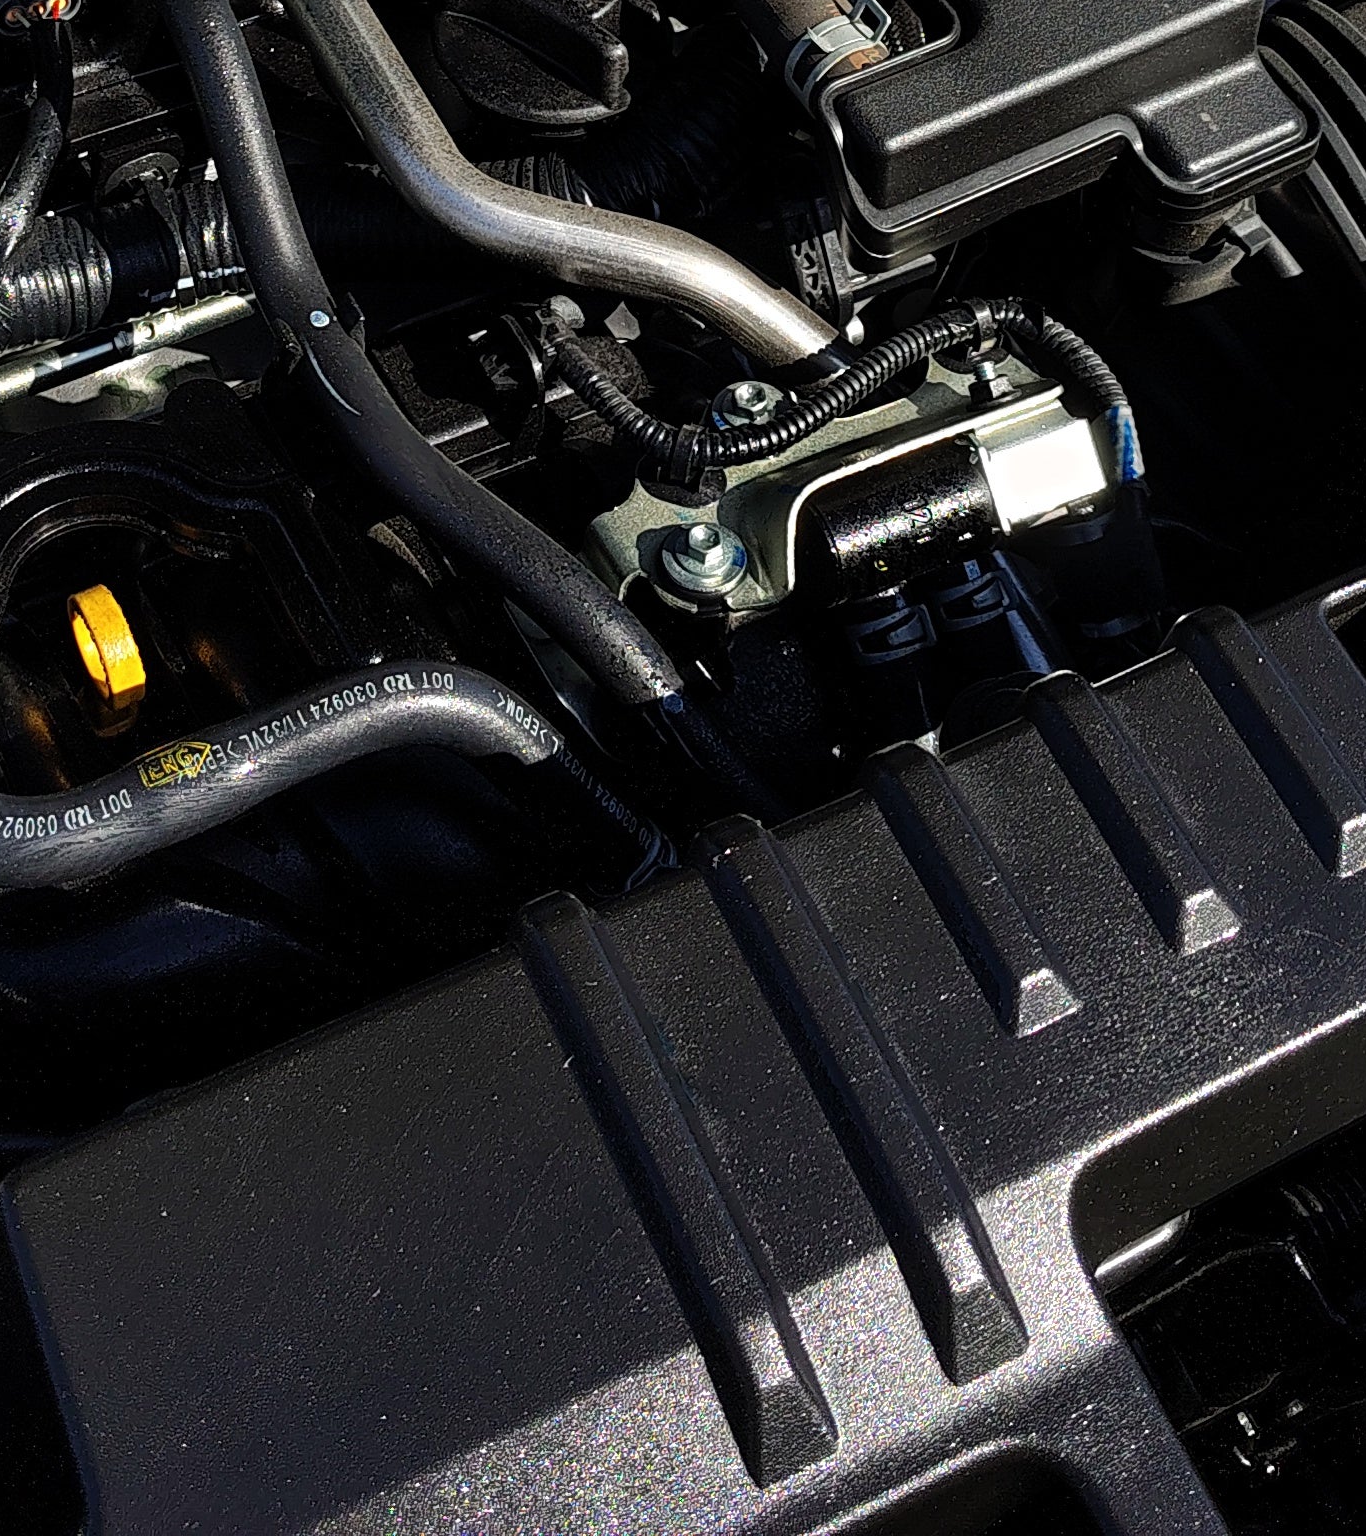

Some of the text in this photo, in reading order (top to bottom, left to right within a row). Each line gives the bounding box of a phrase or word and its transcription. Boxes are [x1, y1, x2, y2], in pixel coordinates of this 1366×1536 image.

[421, 671, 455, 691] DOT
[310, 682, 377, 721] 030924
[99, 788, 133, 820] DOT
[596, 784, 639, 835] 030924
